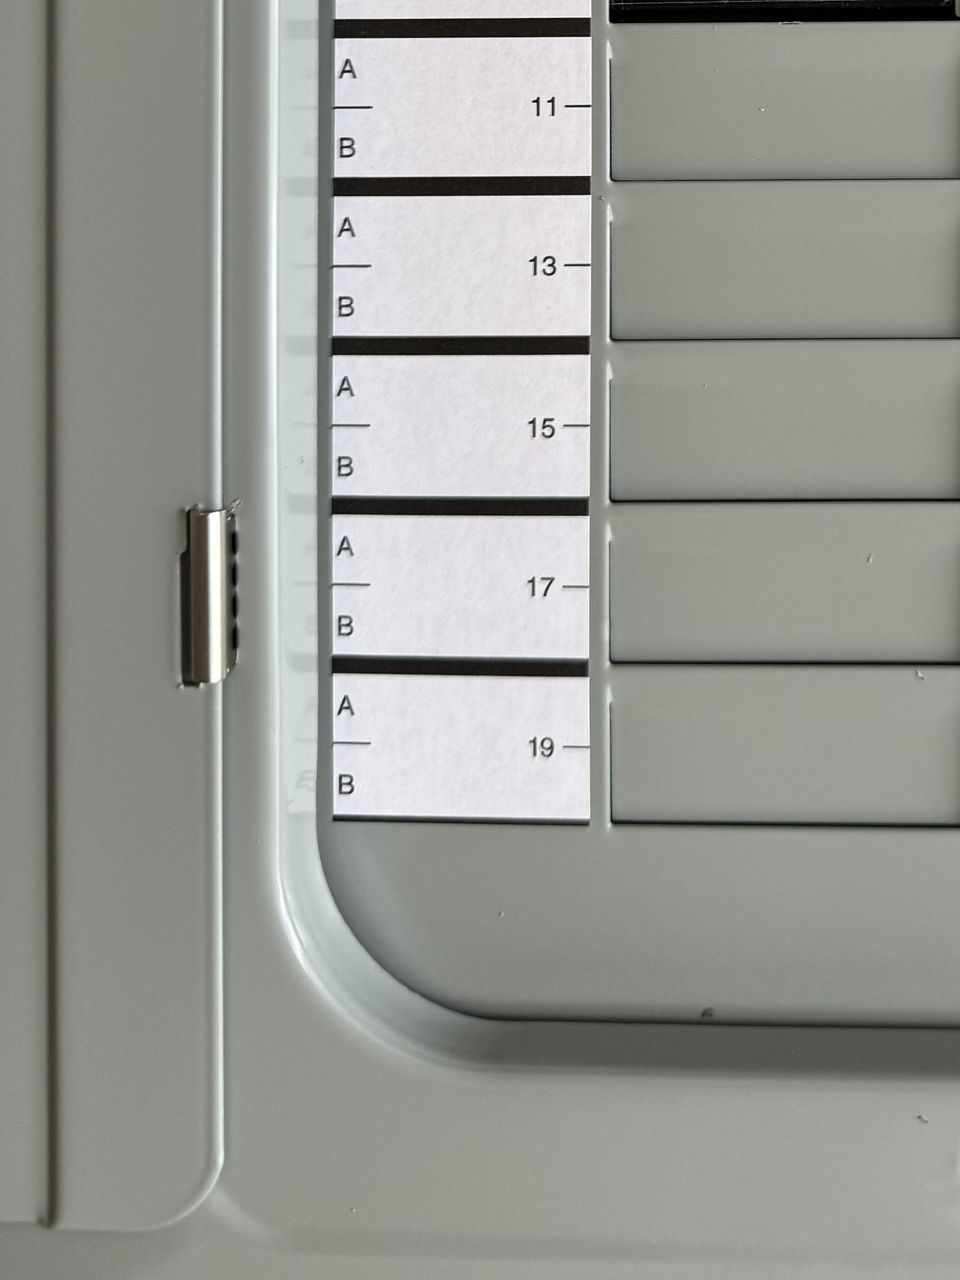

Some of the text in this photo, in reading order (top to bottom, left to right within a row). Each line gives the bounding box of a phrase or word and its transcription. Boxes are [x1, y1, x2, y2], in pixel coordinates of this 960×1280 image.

[338, 58, 357, 79] A
[531, 96, 556, 117] 11
[339, 136, 356, 159] B
[337, 216, 356, 238] A
[528, 255, 557, 277] 13
[337, 295, 355, 318] B
[336, 375, 355, 398] A
[527, 417, 556, 439] 15
[337, 455, 354, 477] B
[336, 535, 354, 557] A
[527, 576, 555, 598] 17
[337, 614, 354, 637] B
[336, 694, 355, 716] A
[528, 736, 555, 758] 19
[338, 773, 355, 795] B
